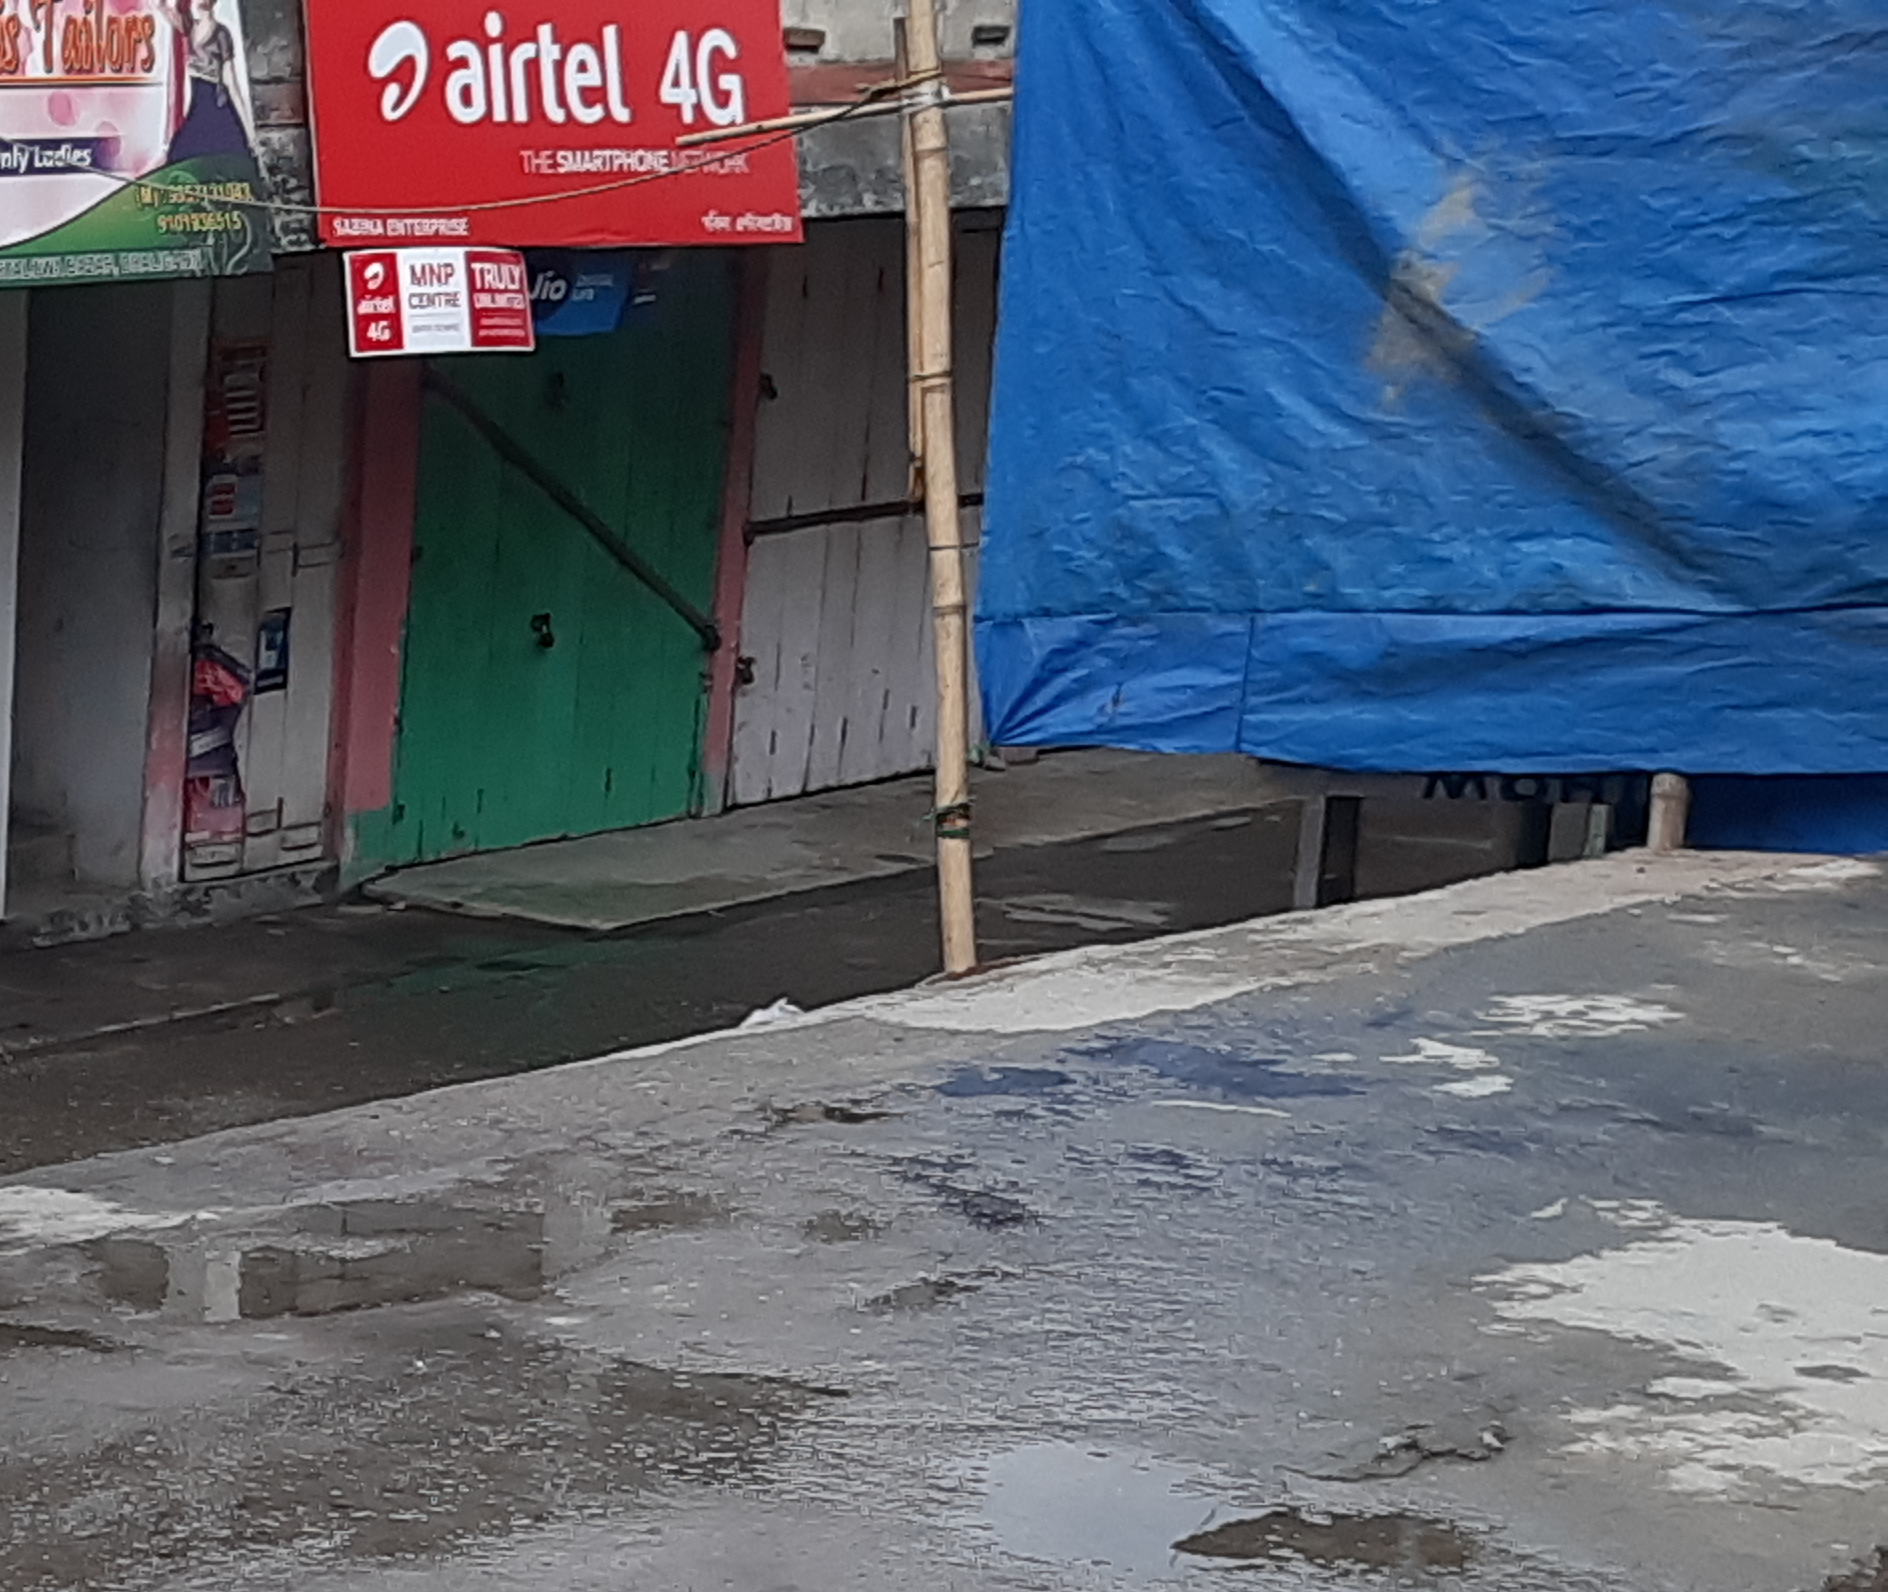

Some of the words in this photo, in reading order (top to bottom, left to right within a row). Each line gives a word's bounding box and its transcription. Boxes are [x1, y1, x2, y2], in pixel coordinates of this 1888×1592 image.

[30, 0, 156, 75] Tailors
[444, 11, 632, 126] airtel
[658, 29, 745, 126] 4G
[32, 144, 92, 168] Ladies
[520, 151, 555, 174] THE
[556, 151, 669, 174] SMARTPHONE
[409, 262, 456, 288] MNP
[470, 262, 522, 291] TRULY
[525, 270, 567, 301] Jio
[408, 291, 462, 310] CENTRE
[366, 319, 392, 341] 4G
